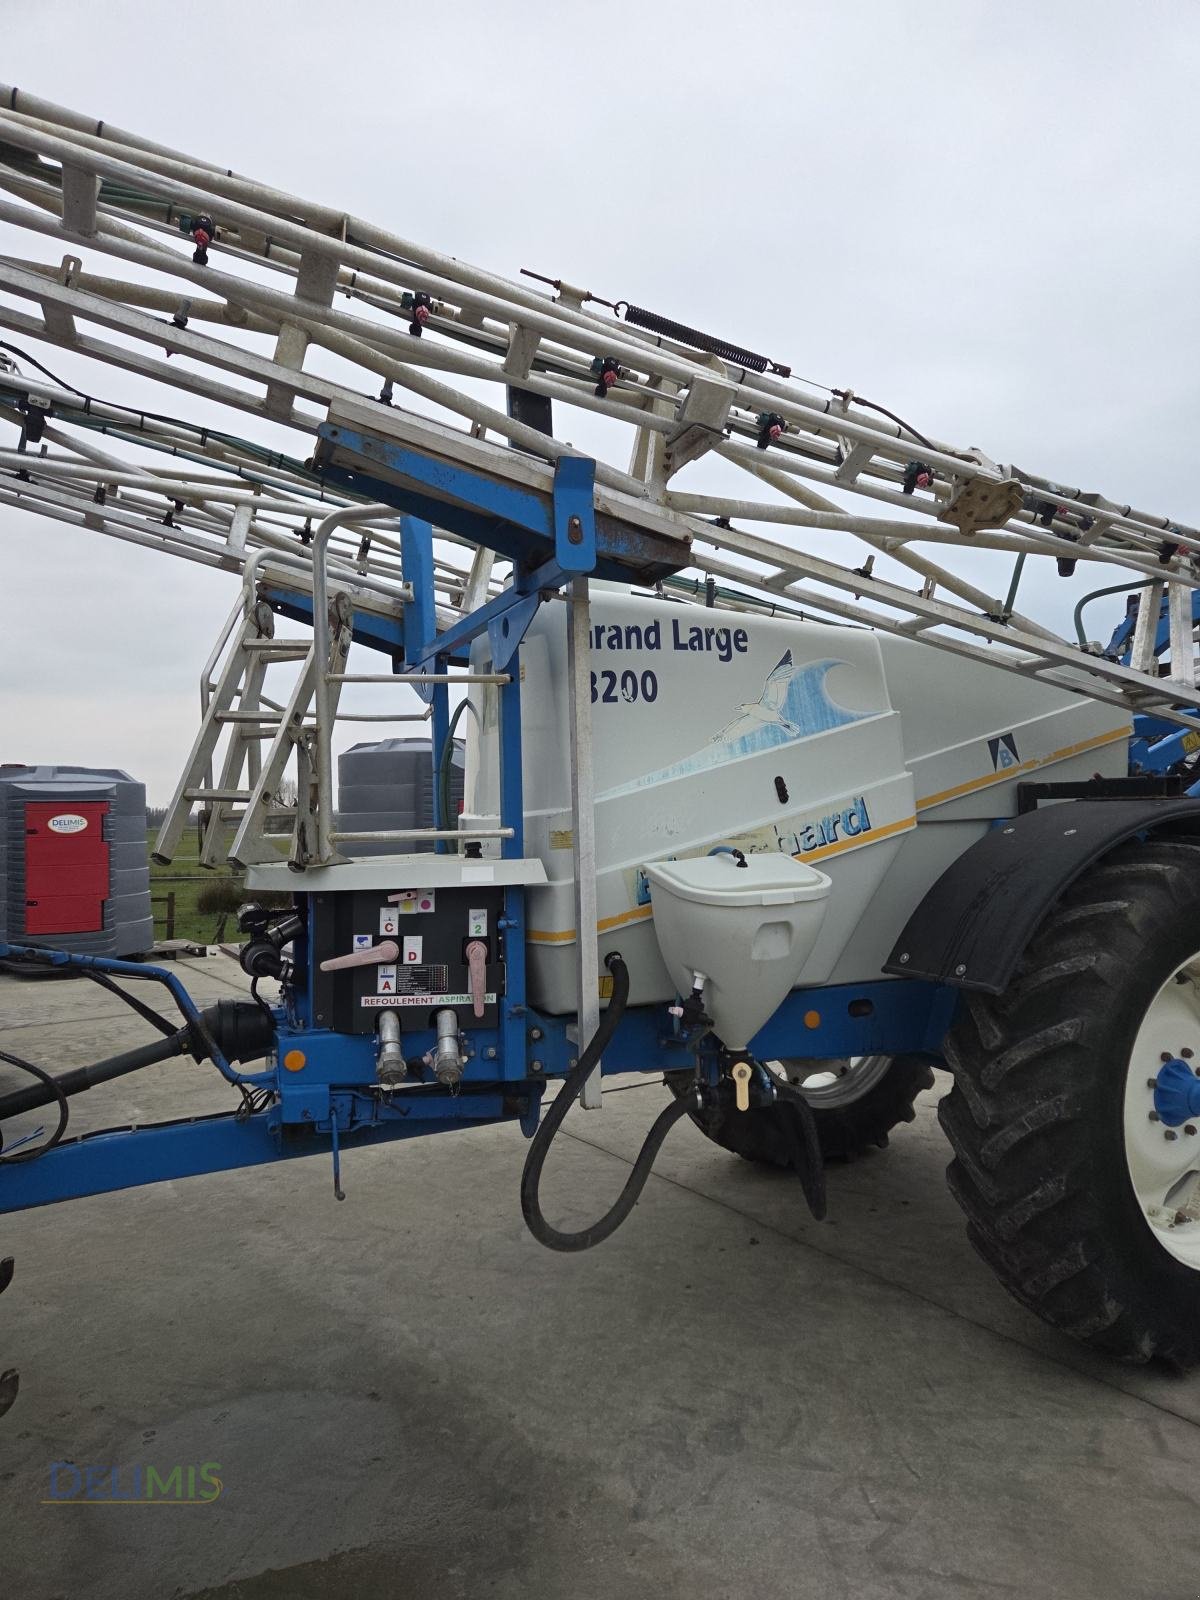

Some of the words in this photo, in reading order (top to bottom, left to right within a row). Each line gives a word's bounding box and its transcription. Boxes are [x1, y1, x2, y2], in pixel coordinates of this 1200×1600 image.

[590, 619, 661, 650] rand
[672, 619, 748, 662] Large
[52, 819, 86, 827] DELIMIS
[385, 923, 394, 933] C
[475, 925, 482, 934] 2
[408, 952, 417, 961] D
[382, 981, 391, 990] A
[364, 997, 433, 1006] REFOULEMENT
[439, 993, 494, 1004] ASPIRAN
